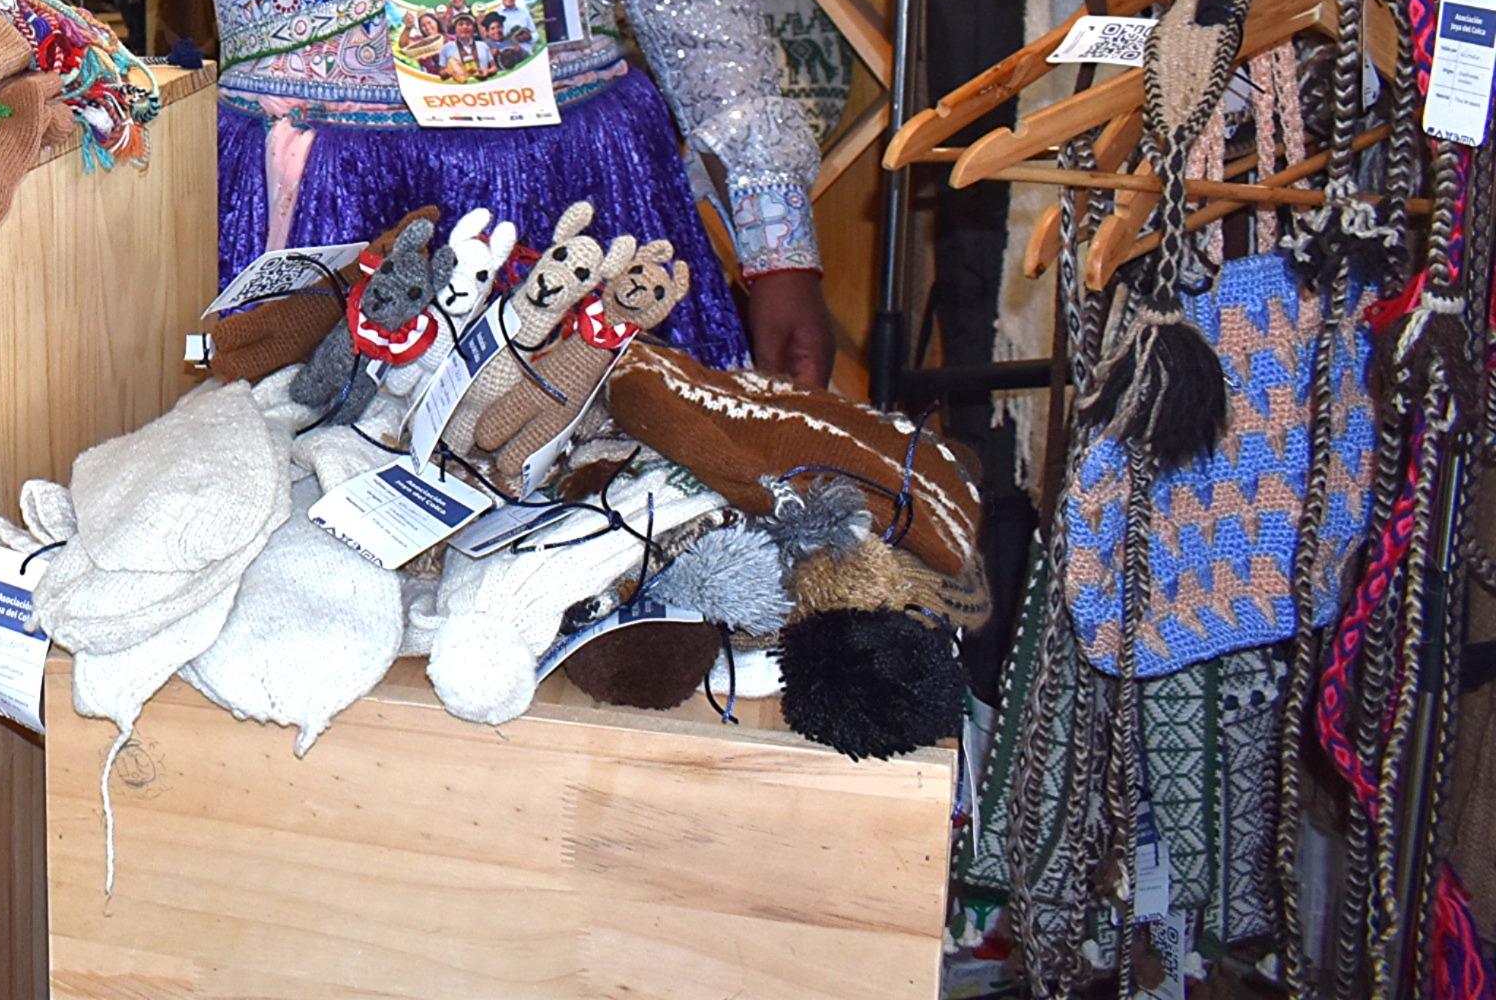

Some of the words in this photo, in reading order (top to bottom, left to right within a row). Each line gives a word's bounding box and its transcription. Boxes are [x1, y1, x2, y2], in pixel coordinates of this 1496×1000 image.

[423, 87, 536, 108] EXPOSITOR
[394, 480, 412, 493] Joya
[412, 491, 426, 502] del
[425, 500, 447, 515] Colca
[406, 480, 447, 507] Asociación
[5, 608, 18, 619] del
